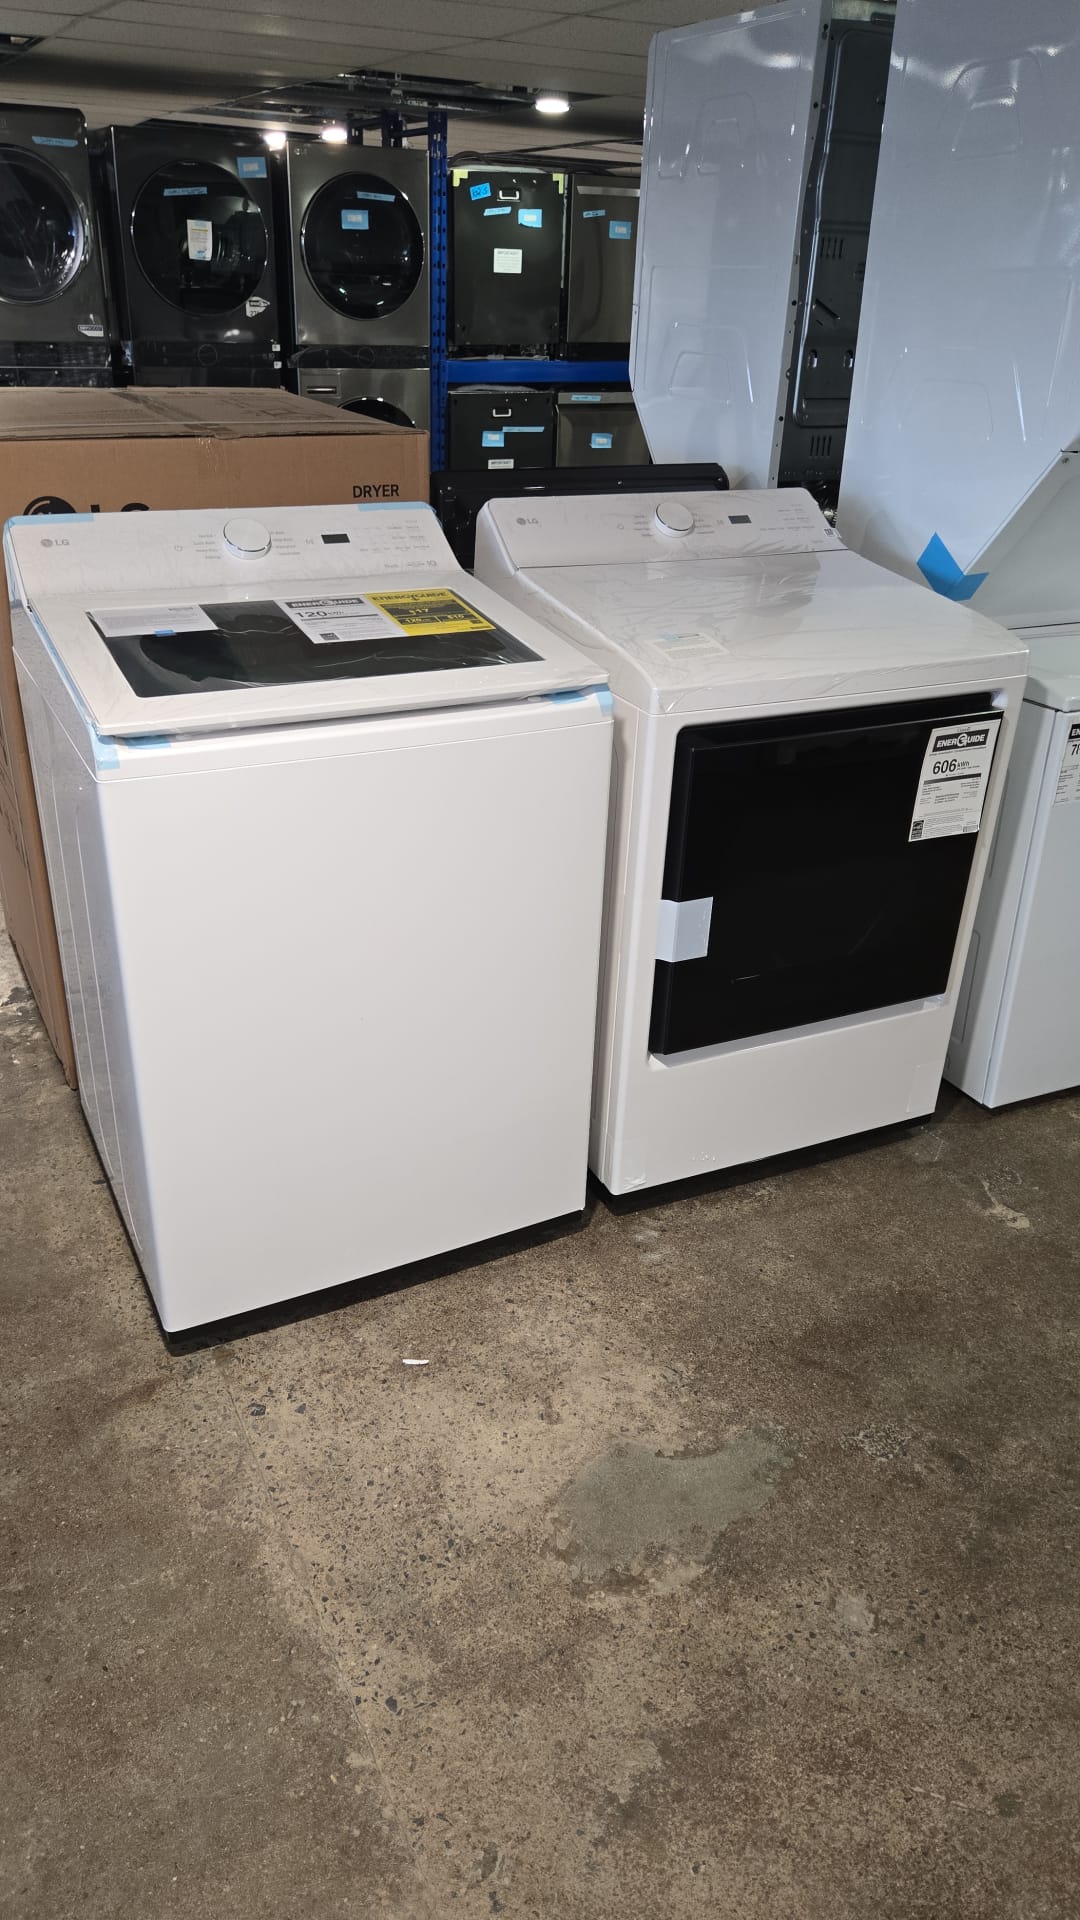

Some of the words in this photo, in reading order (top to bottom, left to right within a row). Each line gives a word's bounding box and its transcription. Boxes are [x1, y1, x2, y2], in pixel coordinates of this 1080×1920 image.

[353, 484, 399, 498] DRYER
[295, 610, 327, 618] 120
[936, 733, 986, 748] ENERGUIDE
[932, 758, 957, 775] 606
